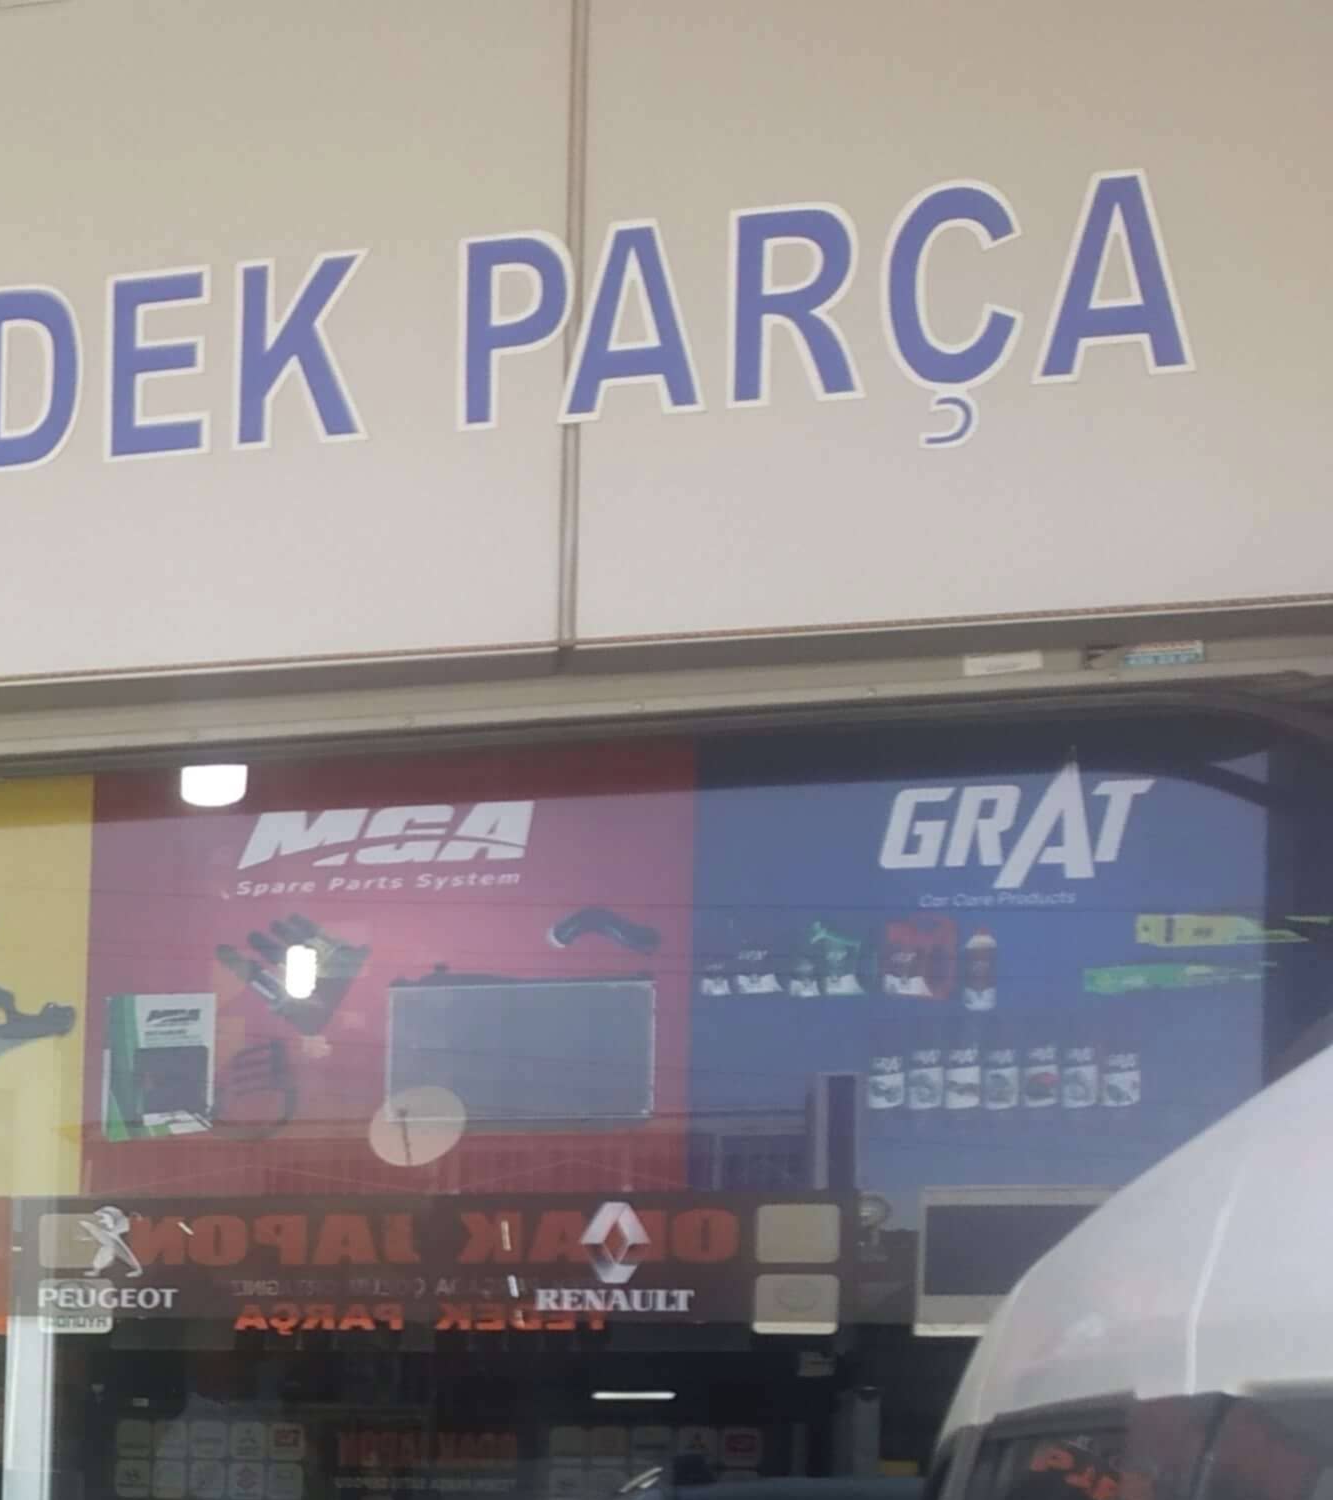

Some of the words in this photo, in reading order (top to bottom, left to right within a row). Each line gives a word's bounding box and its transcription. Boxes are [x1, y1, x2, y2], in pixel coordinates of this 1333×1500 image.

[457, 168, 1196, 449] PARÇA
[237, 800, 534, 869] MGA
[878, 747, 1156, 889] GRAT
[236, 878, 315, 898] Spare
[328, 873, 403, 893] Parts
[416, 869, 521, 894] System
[38, 1288, 179, 1310] PEUGEOT
[536, 1289, 695, 1313] RENAULT
